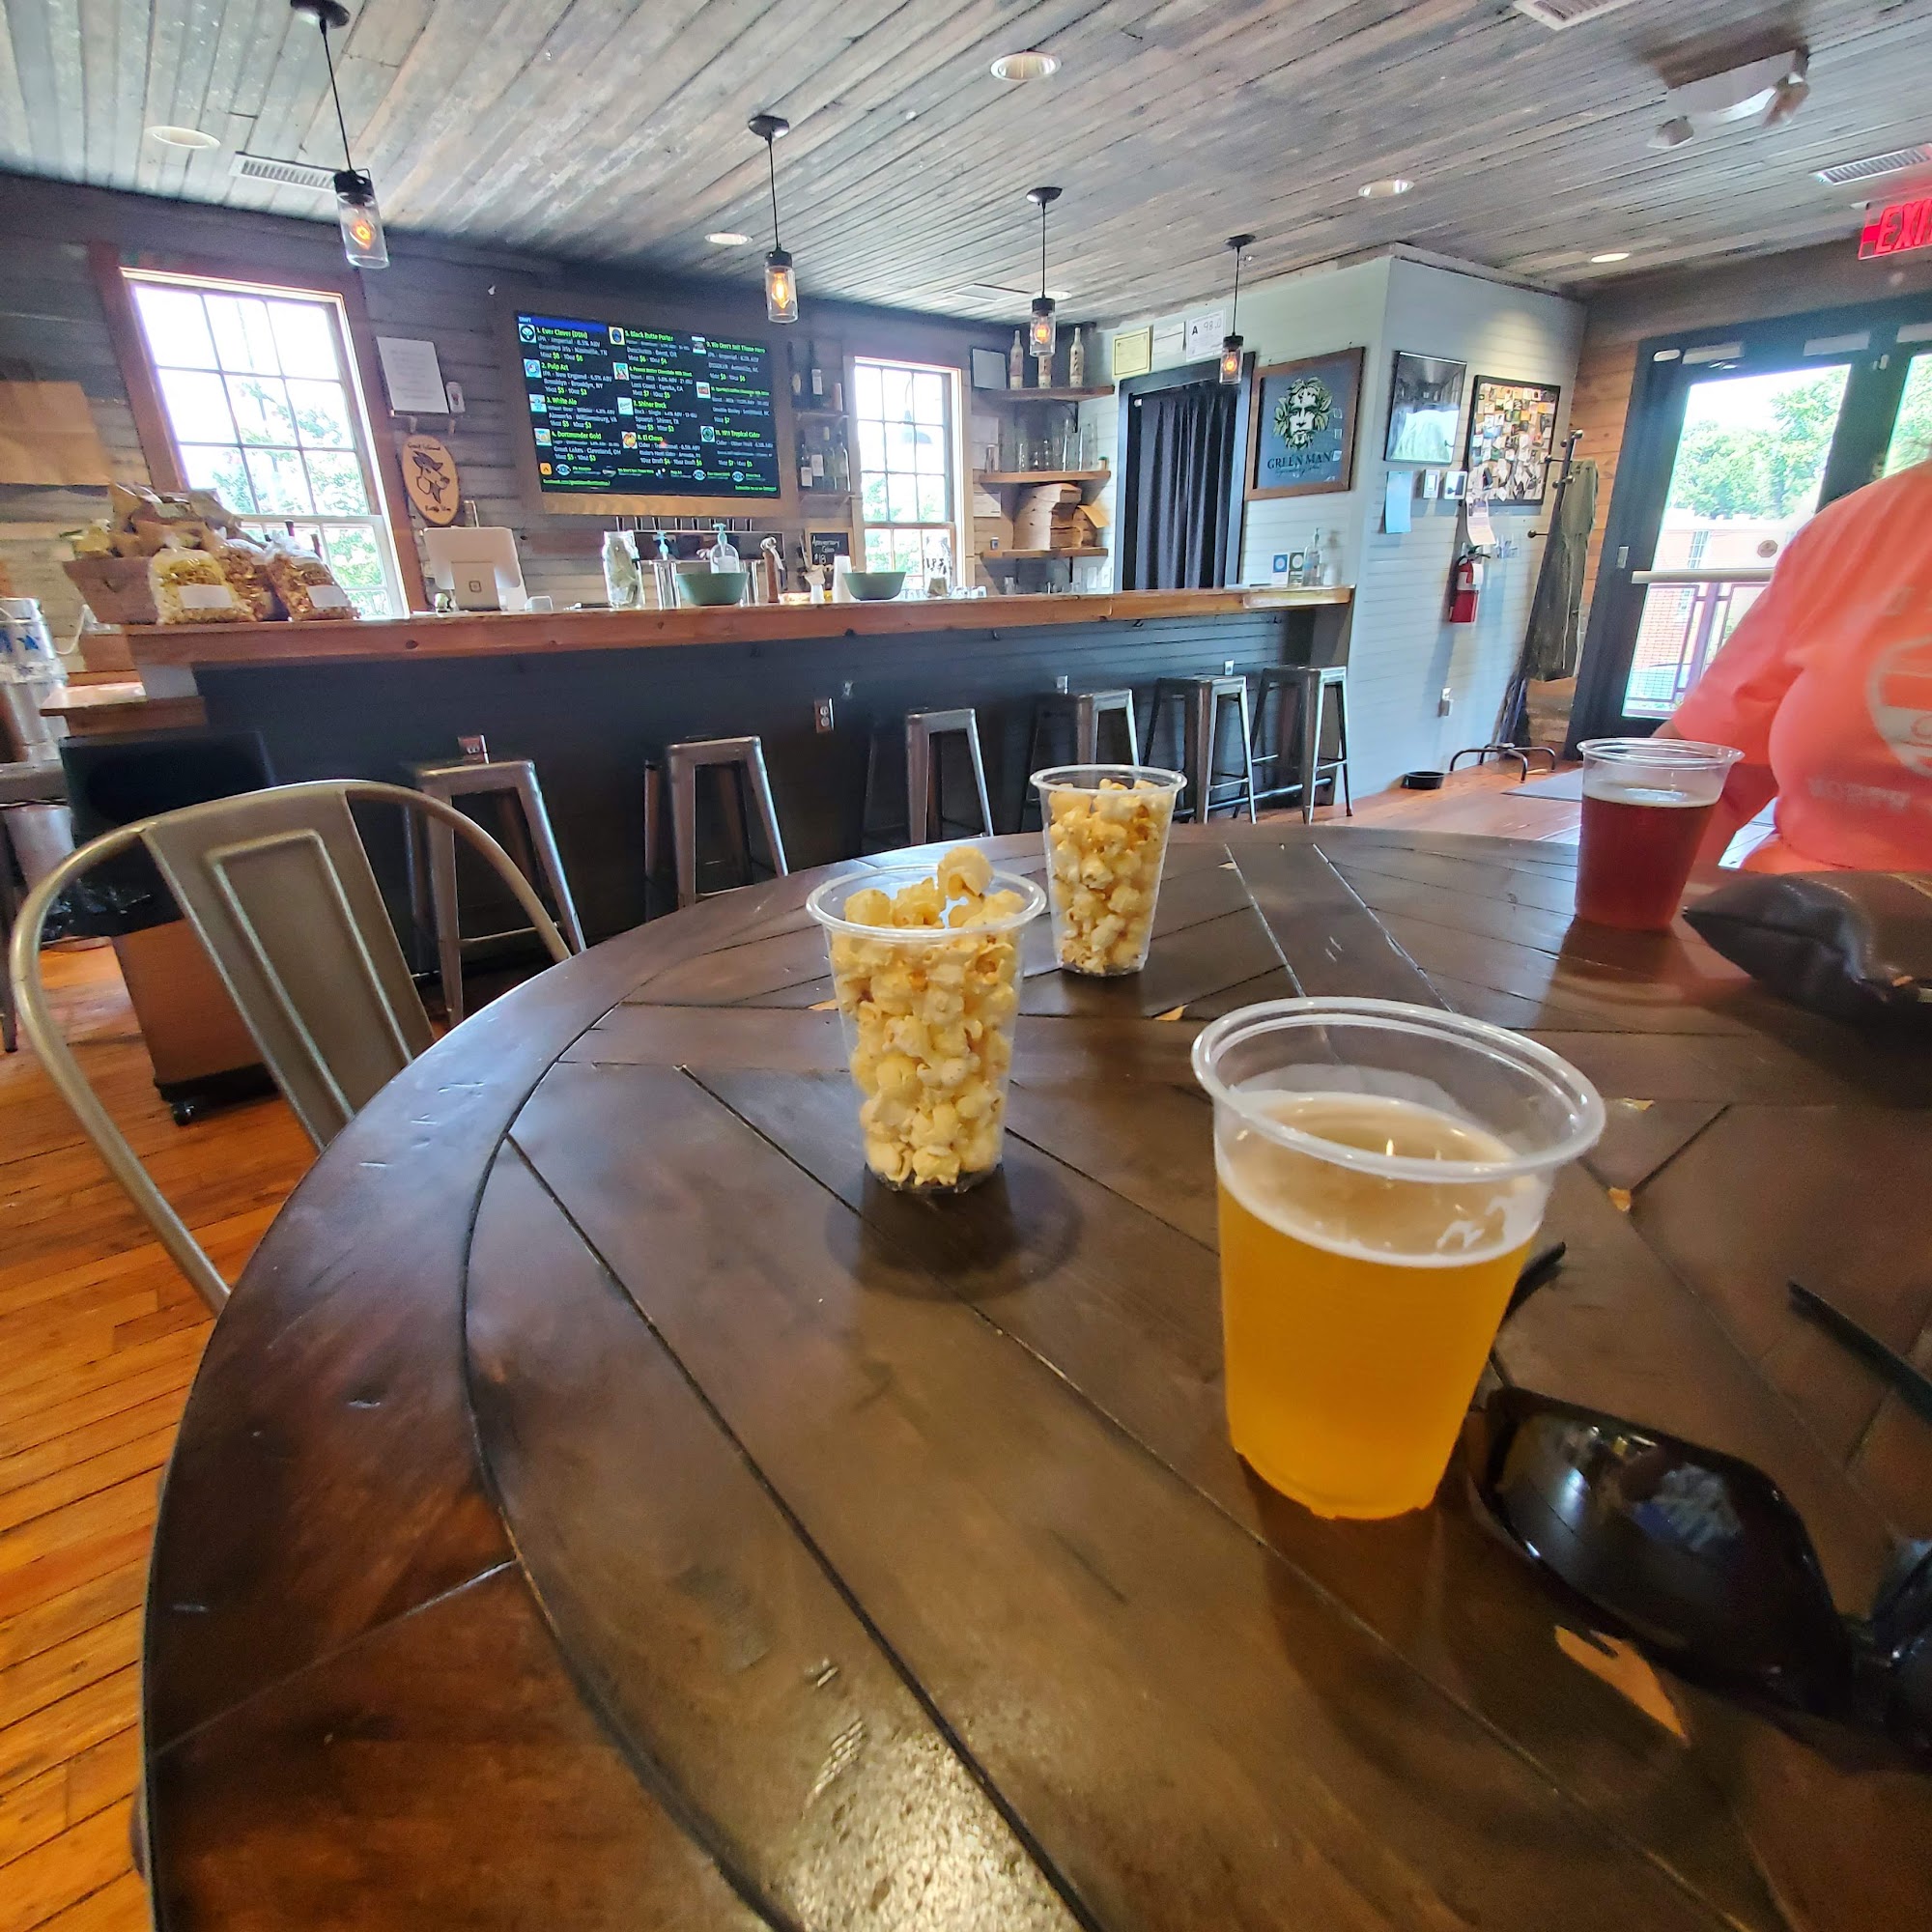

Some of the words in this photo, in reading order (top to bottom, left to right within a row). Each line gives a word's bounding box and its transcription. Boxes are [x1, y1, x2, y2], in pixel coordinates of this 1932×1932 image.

[1875, 199, 1932, 253] EXI
[1192, 326, 1198, 335] A
[547, 363, 559, 371] Pulp
[731, 430, 748, 438] Tropical
[1267, 455, 1303, 469] GREEN
[1306, 451, 1333, 464] MAN
